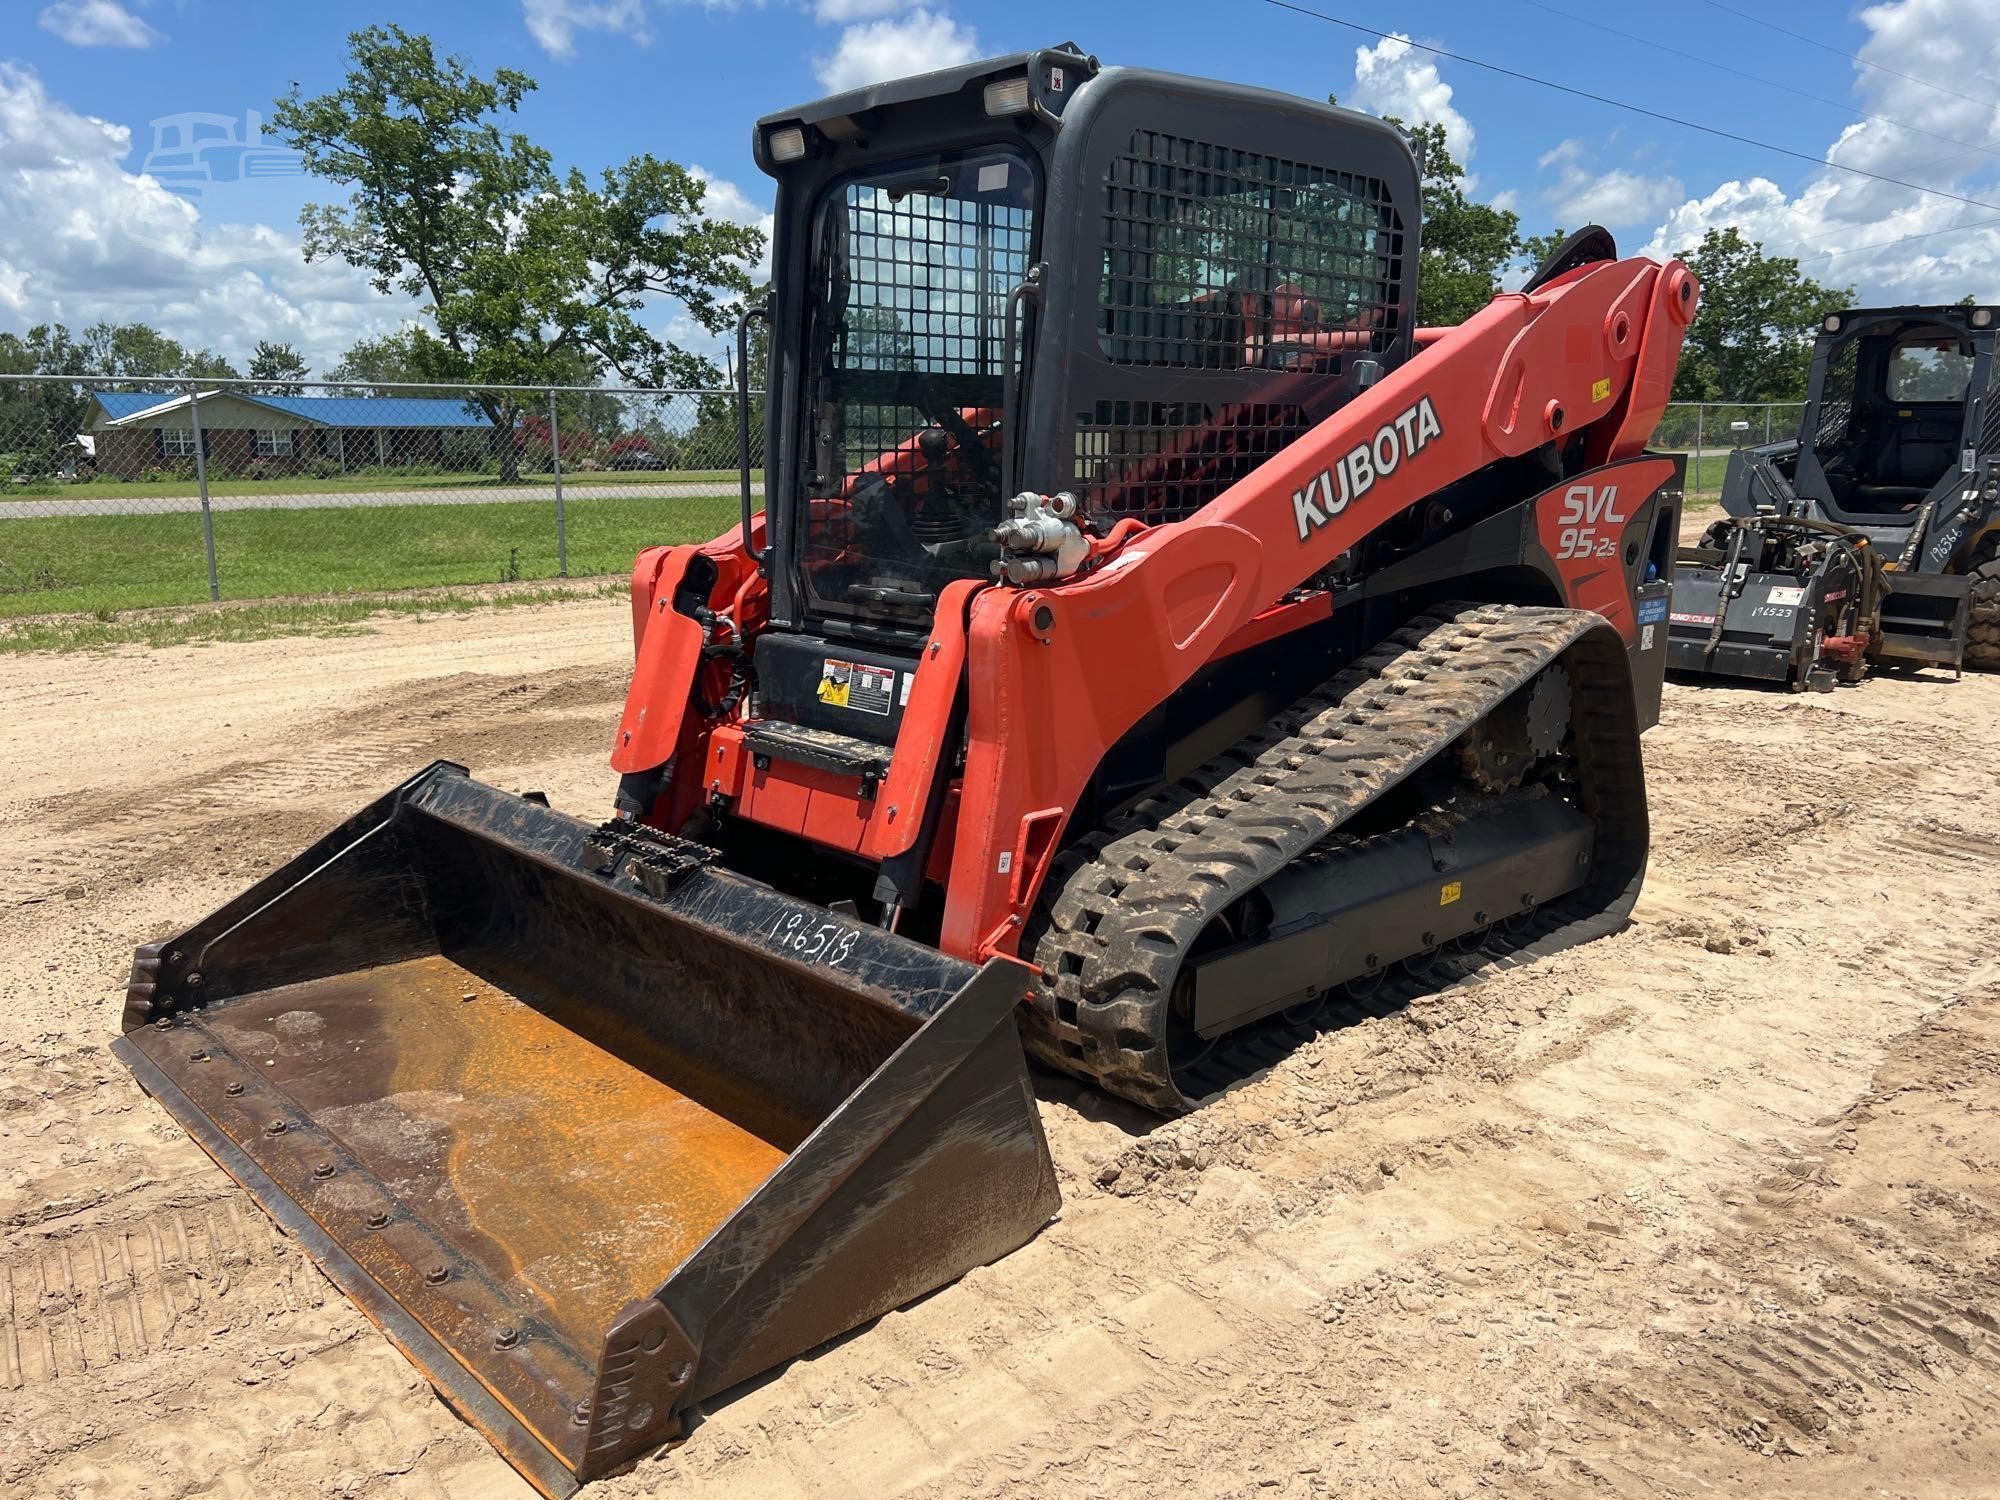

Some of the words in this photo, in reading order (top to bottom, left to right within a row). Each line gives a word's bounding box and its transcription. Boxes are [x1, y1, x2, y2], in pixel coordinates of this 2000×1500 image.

[1292, 395, 1442, 540] KUBOTA
[1558, 485, 1625, 525] SVL
[1751, 606, 1793, 618] 196523
[767, 910, 860, 966] 196518
